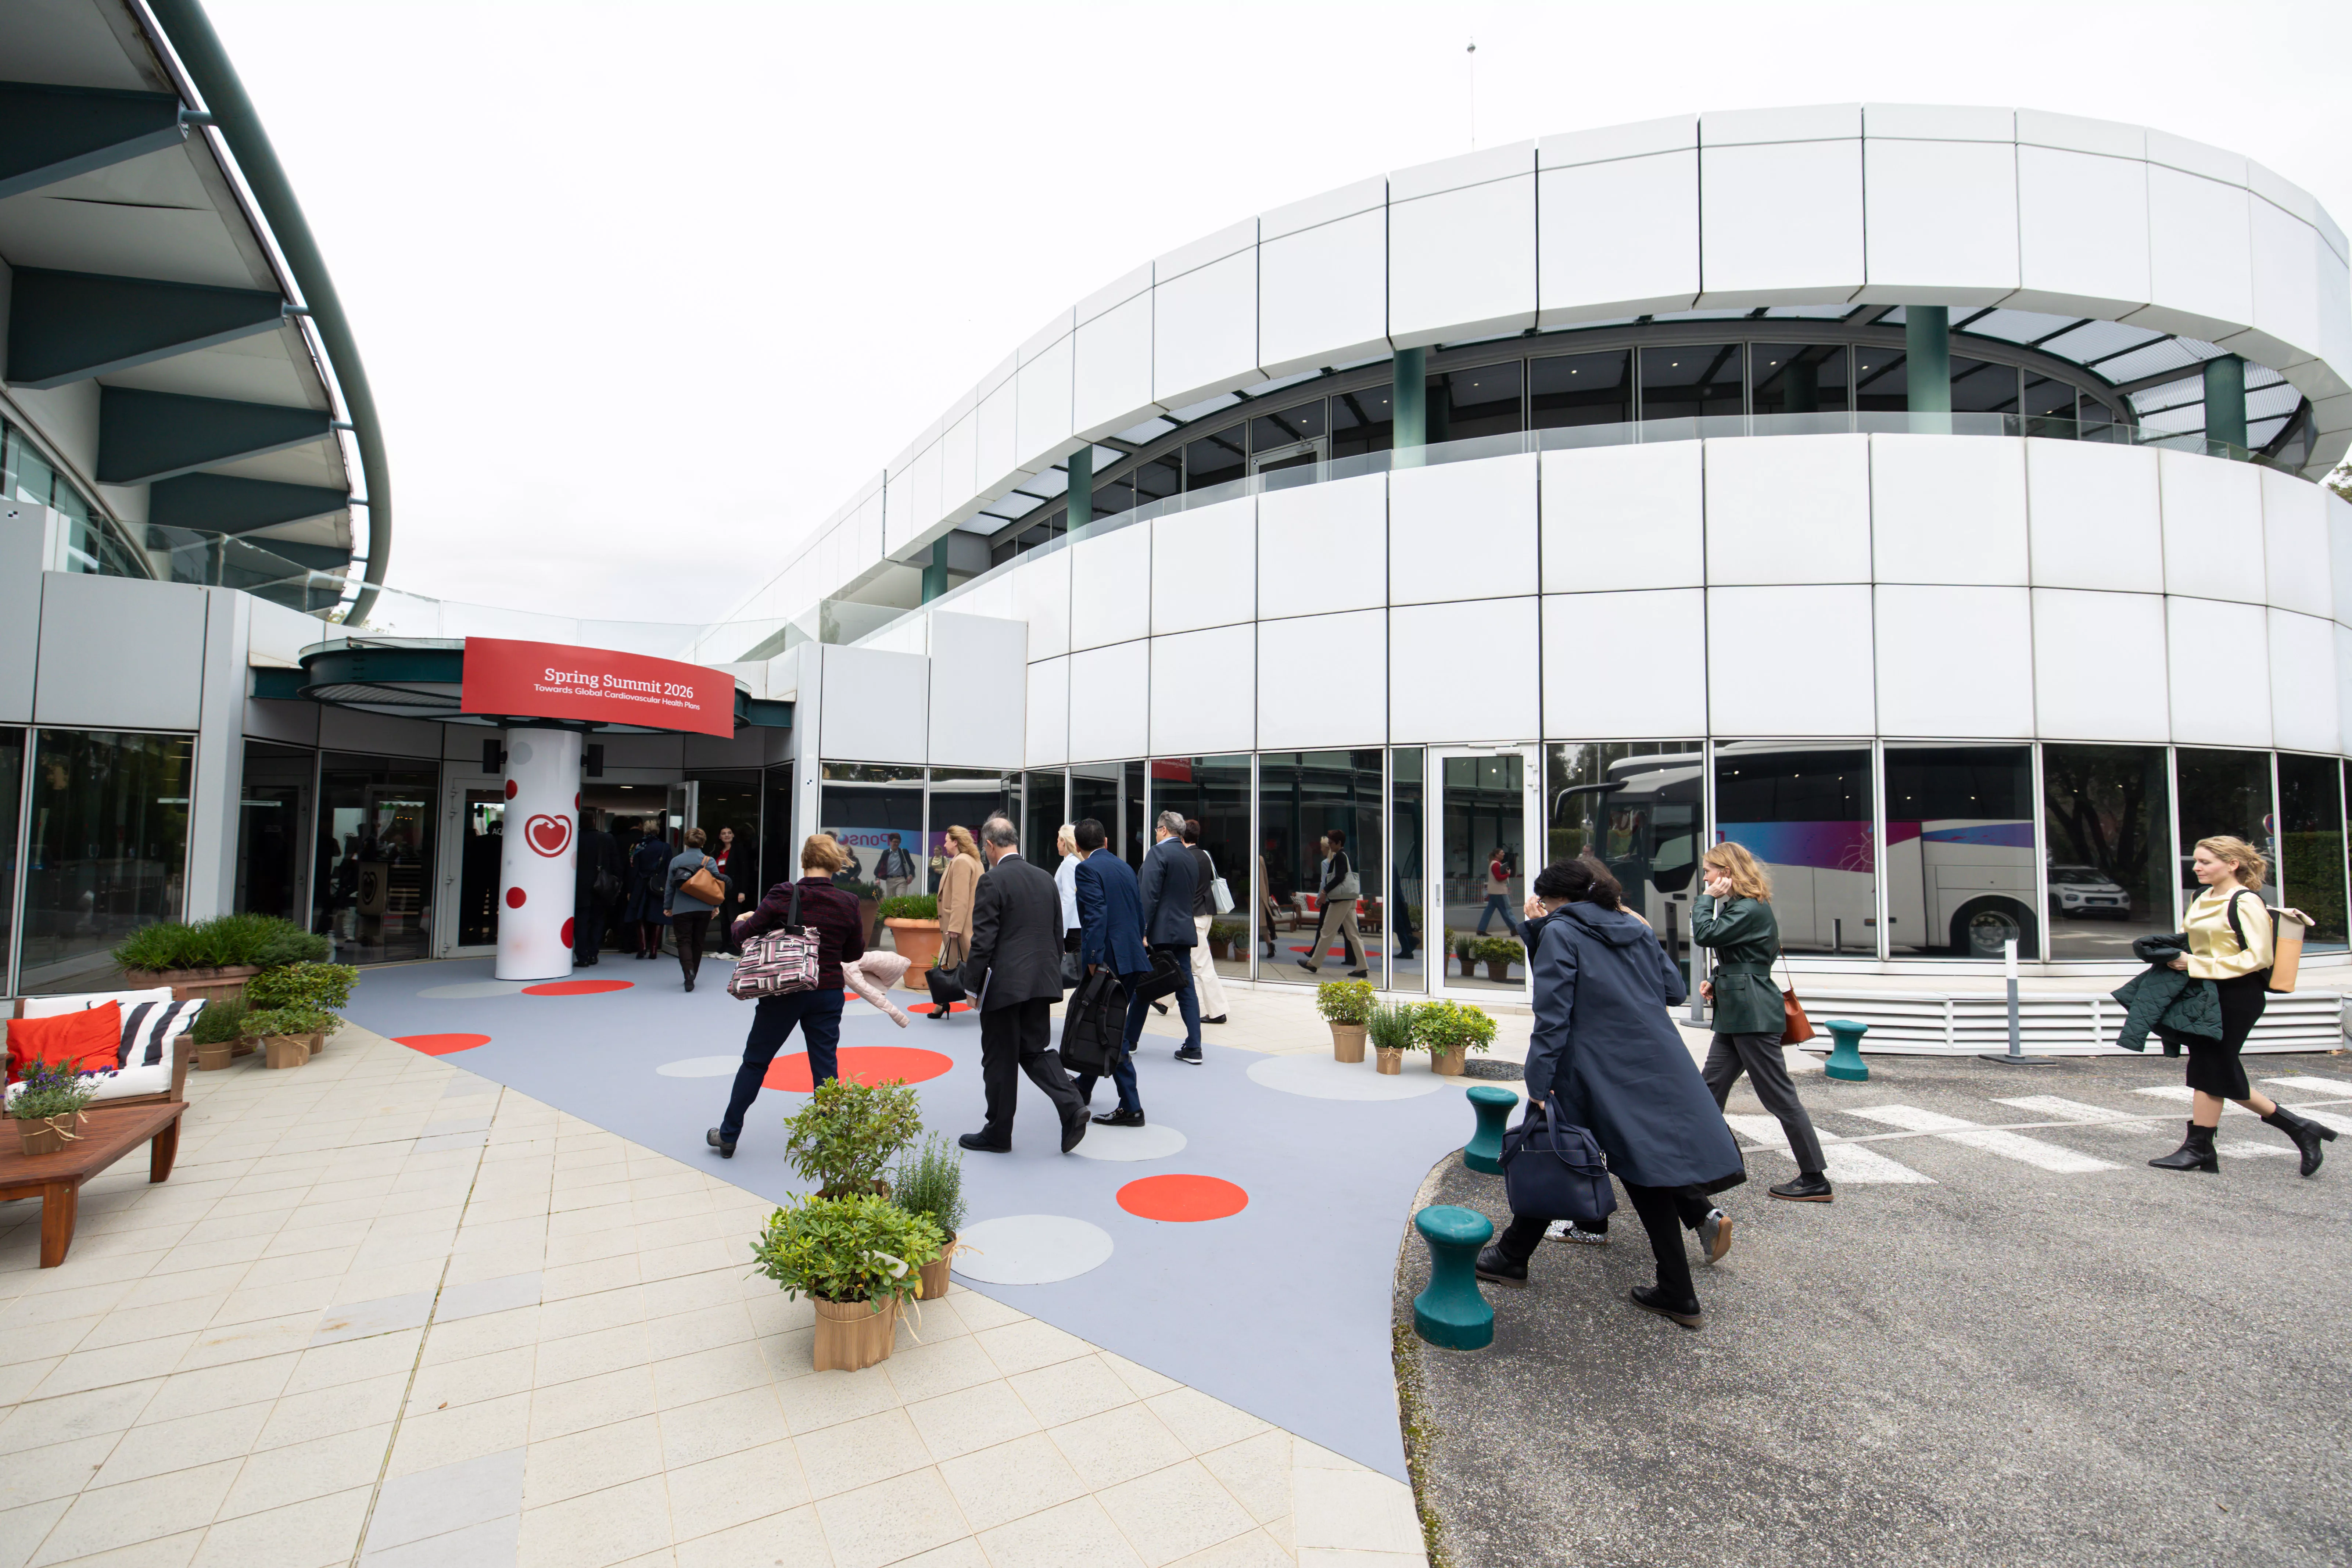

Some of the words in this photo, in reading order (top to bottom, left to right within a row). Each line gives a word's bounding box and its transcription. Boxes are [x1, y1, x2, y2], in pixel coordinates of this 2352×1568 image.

[534, 684, 573, 694] Towards
[574, 688, 602, 697] Global
[604, 690, 661, 703] Cardiovascular
[662, 698, 683, 707] Health
[684, 701, 700, 710] Plans
[545, 668, 599, 688] Spring
[603, 674, 662, 693] Summit
[664, 682, 693, 699] 2026
